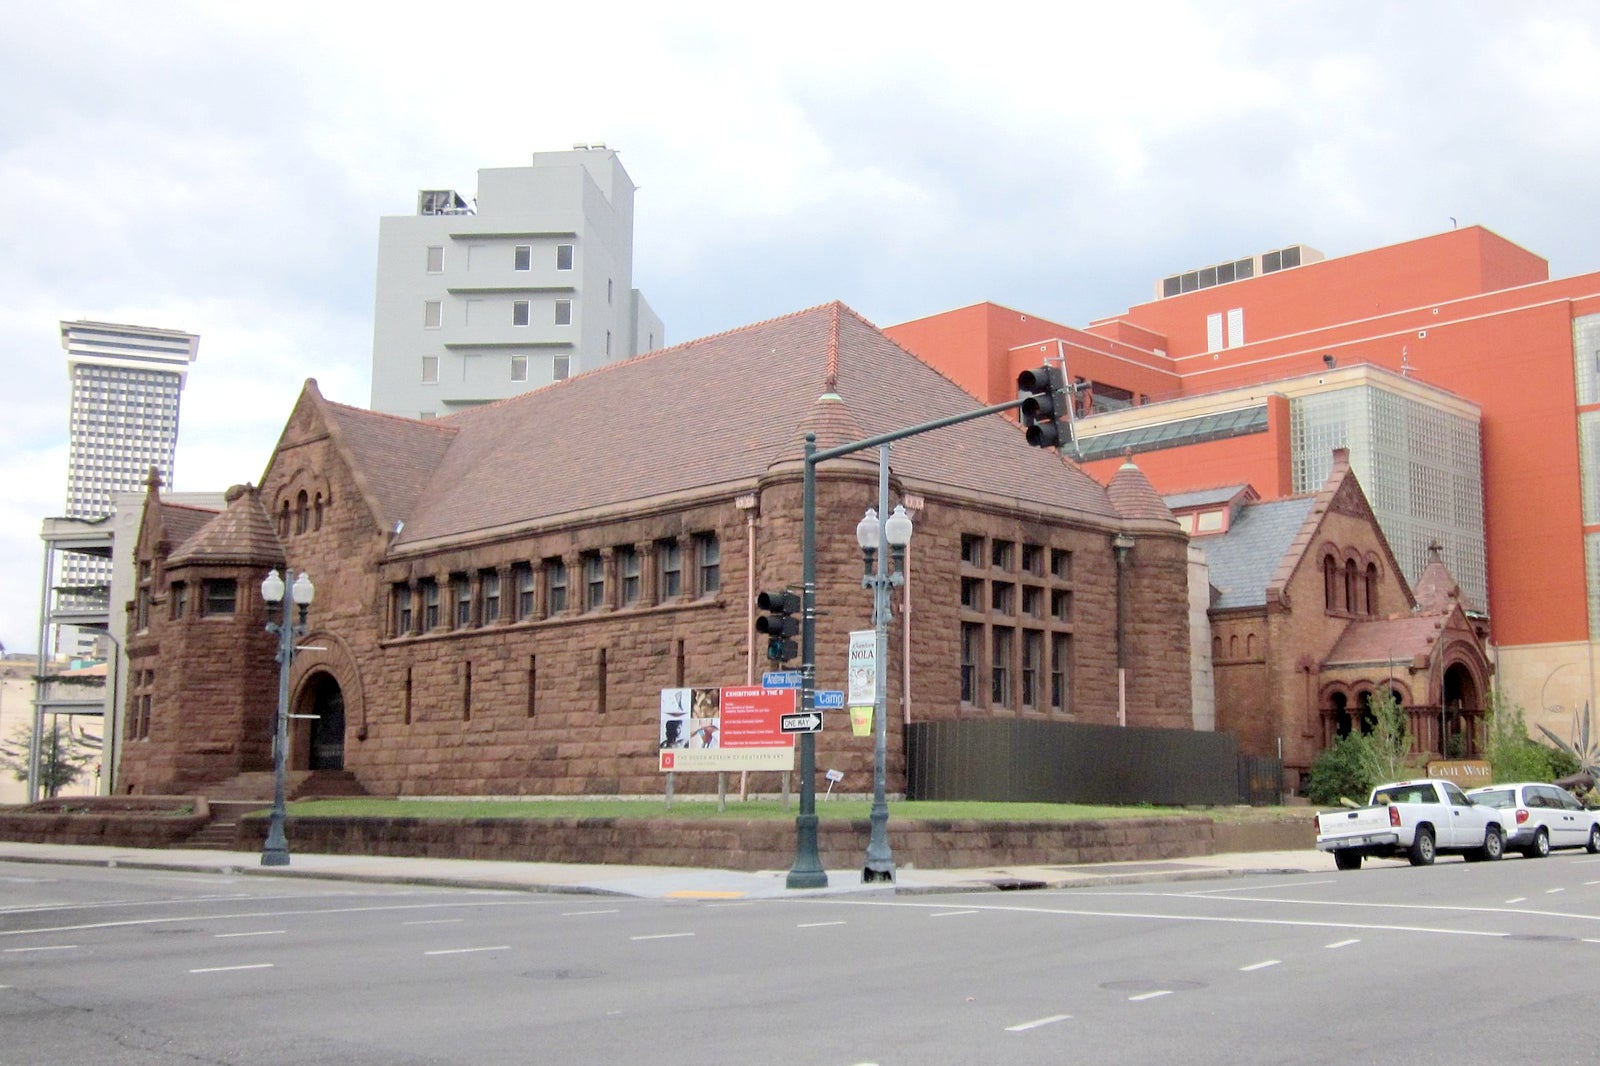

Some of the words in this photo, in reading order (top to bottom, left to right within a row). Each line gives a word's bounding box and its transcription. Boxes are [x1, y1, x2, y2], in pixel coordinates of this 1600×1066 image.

[851, 650, 874, 660] NOLA
[767, 674, 785, 684] Andrew
[820, 692, 843, 706] Camp
[785, 720, 796, 728] ONE
[797, 718, 810, 727] WAY
[1429, 766, 1459, 776] CIVIL
[1463, 764, 1489, 776] WAR
